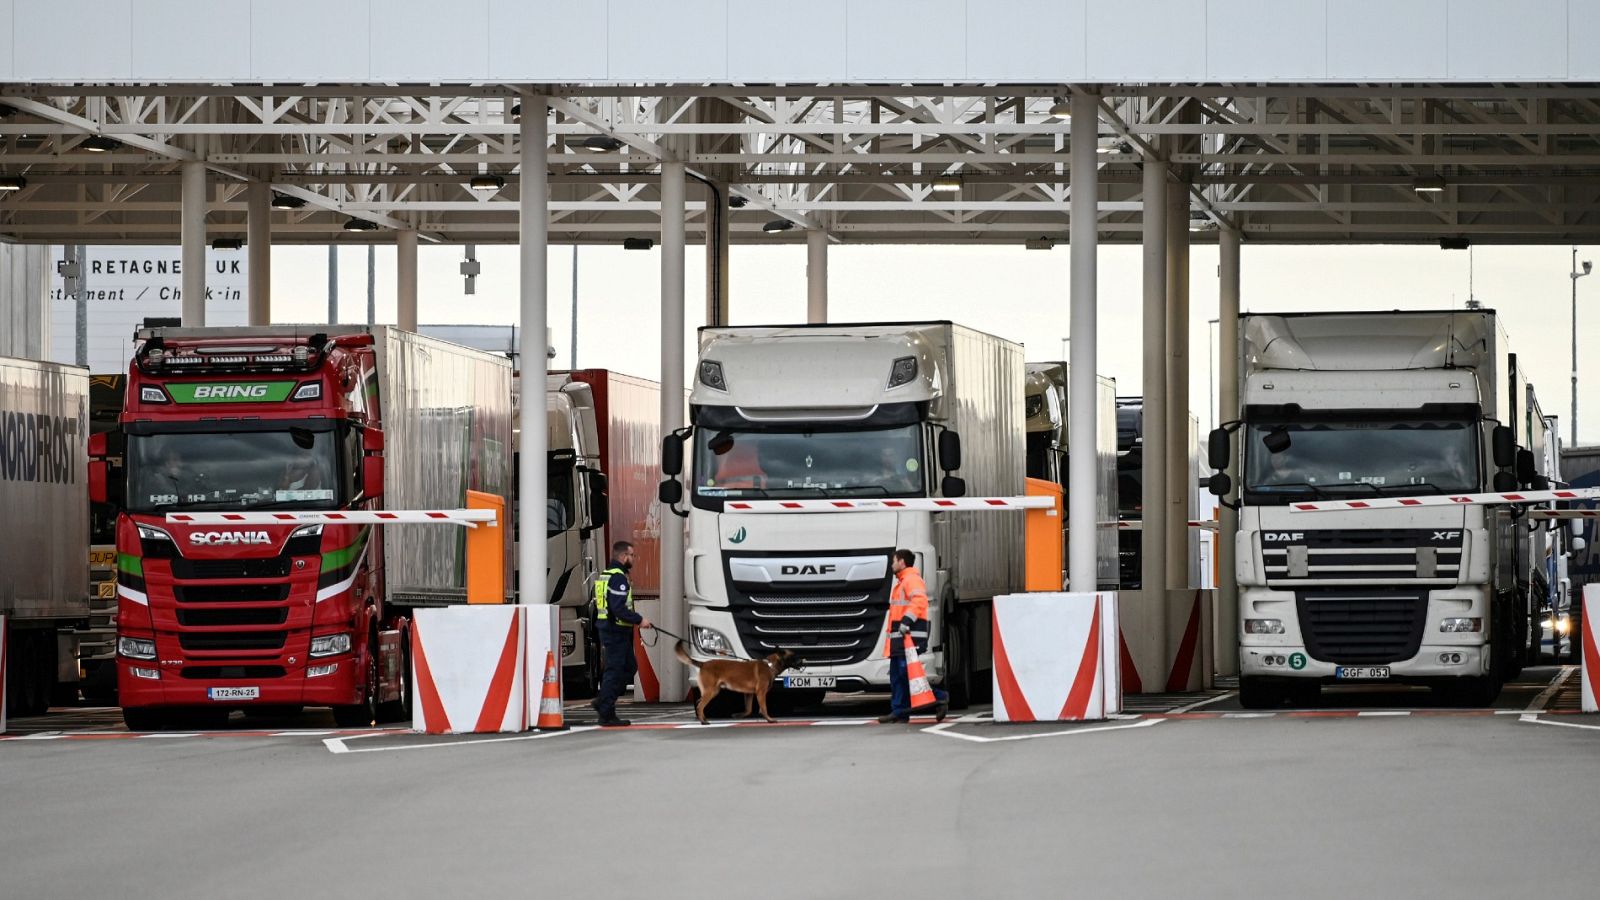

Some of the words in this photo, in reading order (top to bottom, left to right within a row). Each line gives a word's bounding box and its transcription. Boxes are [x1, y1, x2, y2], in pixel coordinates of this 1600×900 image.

[92, 260, 182, 274] RETAGNE
[216, 260, 241, 274] UK
[159, 286, 241, 301] Chk-in
[193, 385, 268, 399] BRING
[0, 410, 77, 485] NORDFROST
[189, 531, 272, 545] SCANIA
[1264, 532, 1304, 542] DAF
[1430, 531, 1461, 541] XF
[89, 552, 114, 563] OUP
[781, 564, 836, 575] DAF
[1293, 654, 1303, 668] 5
[1342, 668, 1364, 678] GGF
[1369, 668, 1388, 678] 053
[789, 677, 811, 687] KDM
[818, 677, 835, 687] 147
[216, 689, 256, 697] 172-RN-25
